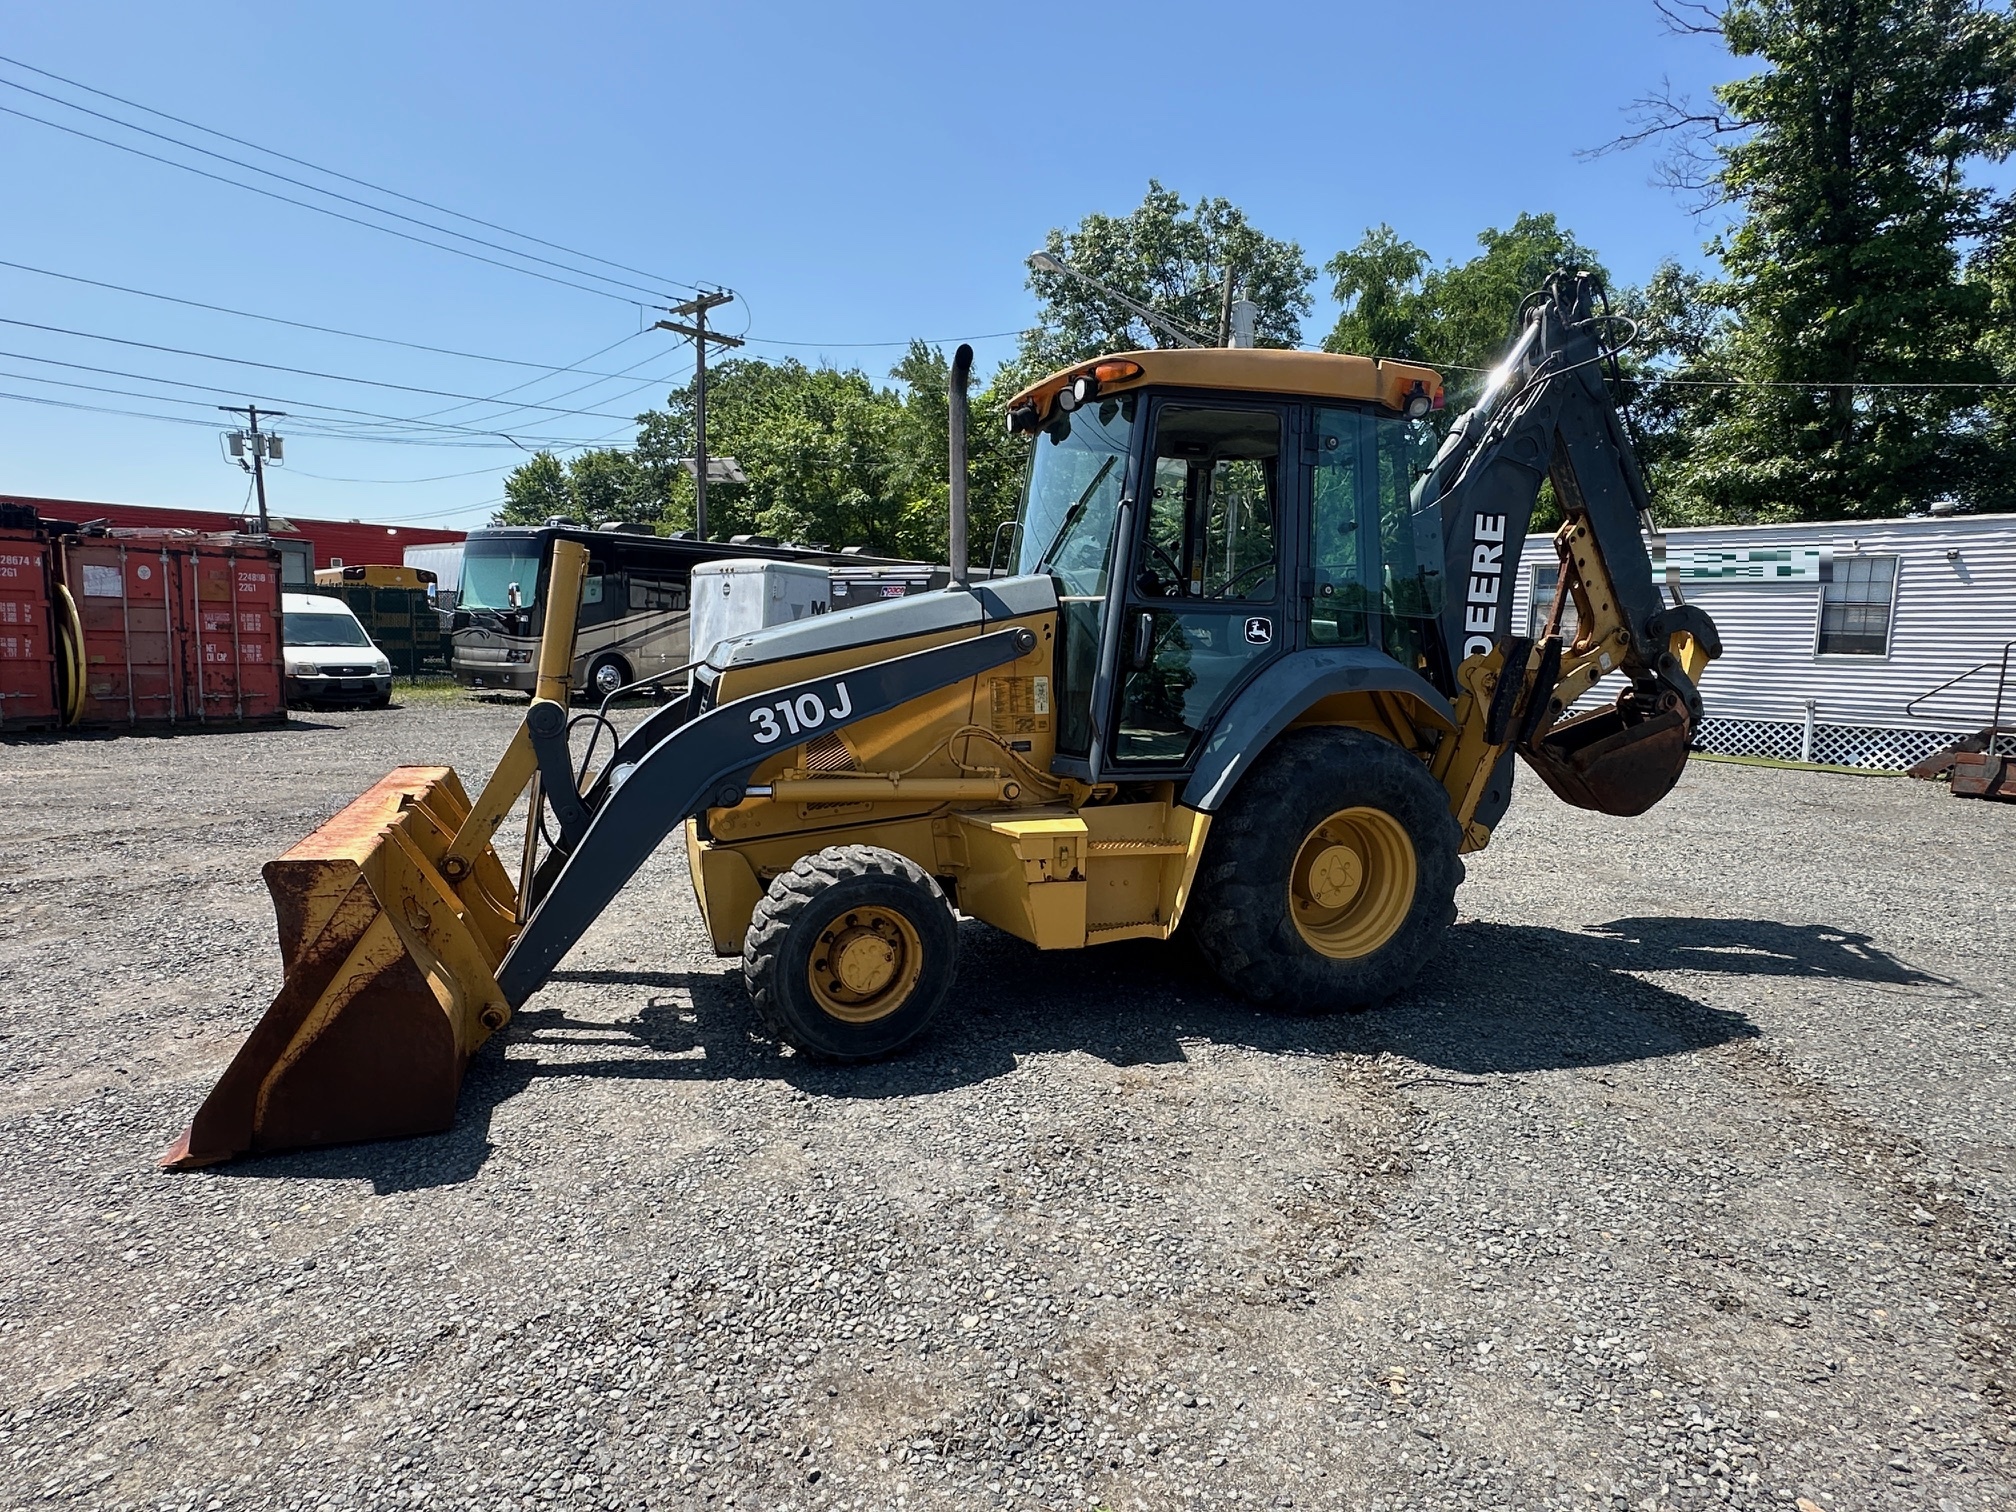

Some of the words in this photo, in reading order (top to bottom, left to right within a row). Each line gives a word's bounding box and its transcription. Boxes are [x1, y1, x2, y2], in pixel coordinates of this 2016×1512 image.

[0, 555, 30, 566] 28674
[34, 557, 41, 567] 4
[0, 567, 17, 577] 2G1
[239, 583, 256, 592] 22G1
[1463, 513, 1506, 661] DEERE
[749, 681, 852, 744] 310J
